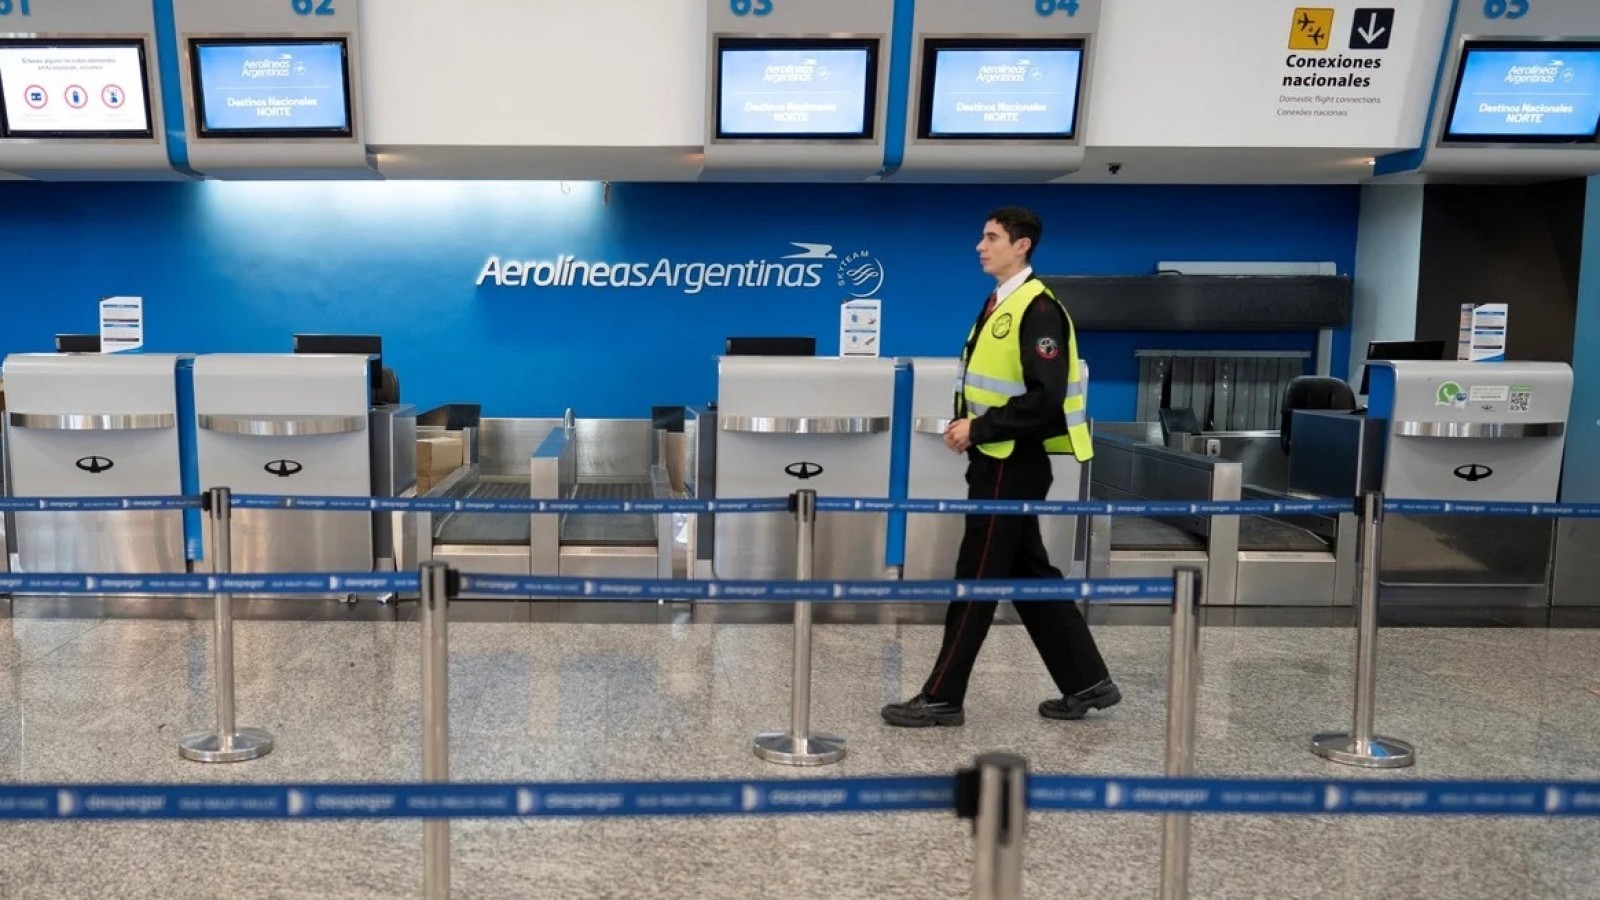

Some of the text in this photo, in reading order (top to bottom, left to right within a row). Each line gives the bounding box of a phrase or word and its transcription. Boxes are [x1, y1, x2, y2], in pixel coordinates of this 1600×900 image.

[1286, 54, 1382, 69] Conexiones
[1282, 73, 1371, 87] nacionales
[227, 97, 318, 107] Destinos Nacionales
[1279, 95, 1381, 105] Domestic flight connections
[256, 107, 293, 117] NORTE
[744, 102, 837, 112] Destinos Nacionales
[956, 102, 1047, 112] Destinos Nacionales
[1479, 103, 1573, 113] Destinos Nacionales
[773, 112, 809, 121] NORTE
[983, 112, 1021, 121] NORTE
[1505, 113, 1545, 123] NORTE
[837, 249, 870, 287] SKYTEAM
